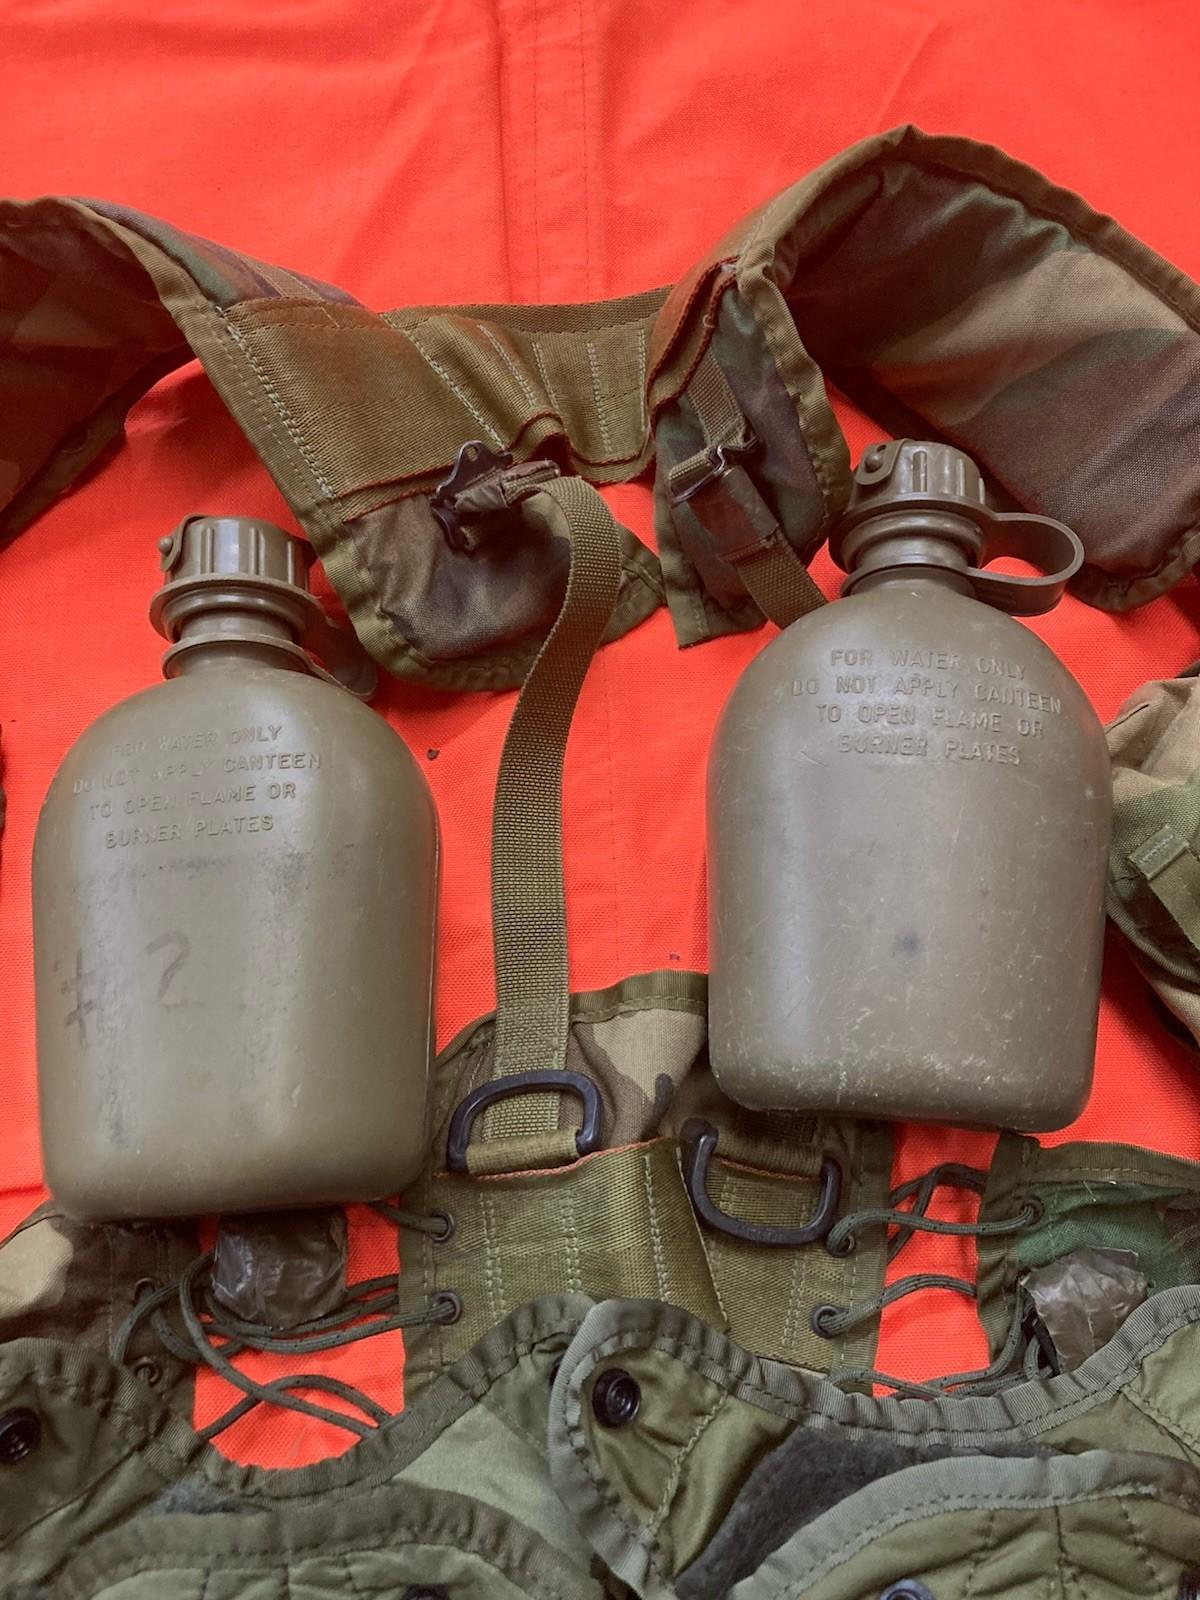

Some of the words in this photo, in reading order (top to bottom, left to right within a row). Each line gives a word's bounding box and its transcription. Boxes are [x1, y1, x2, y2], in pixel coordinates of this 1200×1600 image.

[831, 650, 873, 666] FOR
[892, 651, 960, 670] WATER
[976, 656, 1026, 680] ONLY
[792, 678, 819, 695] DO
[836, 676, 877, 694] NOT
[895, 677, 958, 698] APPLY
[975, 684, 1061, 714] CANTEEN
[160, 731, 219, 750] WATER
[231, 725, 282, 745] ONLY
[817, 705, 841, 722] TO
[858, 705, 916, 724] OPEN
[933, 709, 1002, 732] FLAME
[1018, 718, 1044, 739] OR
[839, 735, 929, 756] BURNER
[944, 739, 1021, 765] PLATES
[102, 768, 140, 789] NOT
[223, 753, 322, 773] CANTEEN
[87, 803, 113, 821] TO
[124, 795, 178, 814] OPEN
[188, 785, 256, 805] FLAME
[267, 783, 296, 798] OR
[105, 824, 181, 848] BURNER
[194, 815, 274, 837] PLATES
